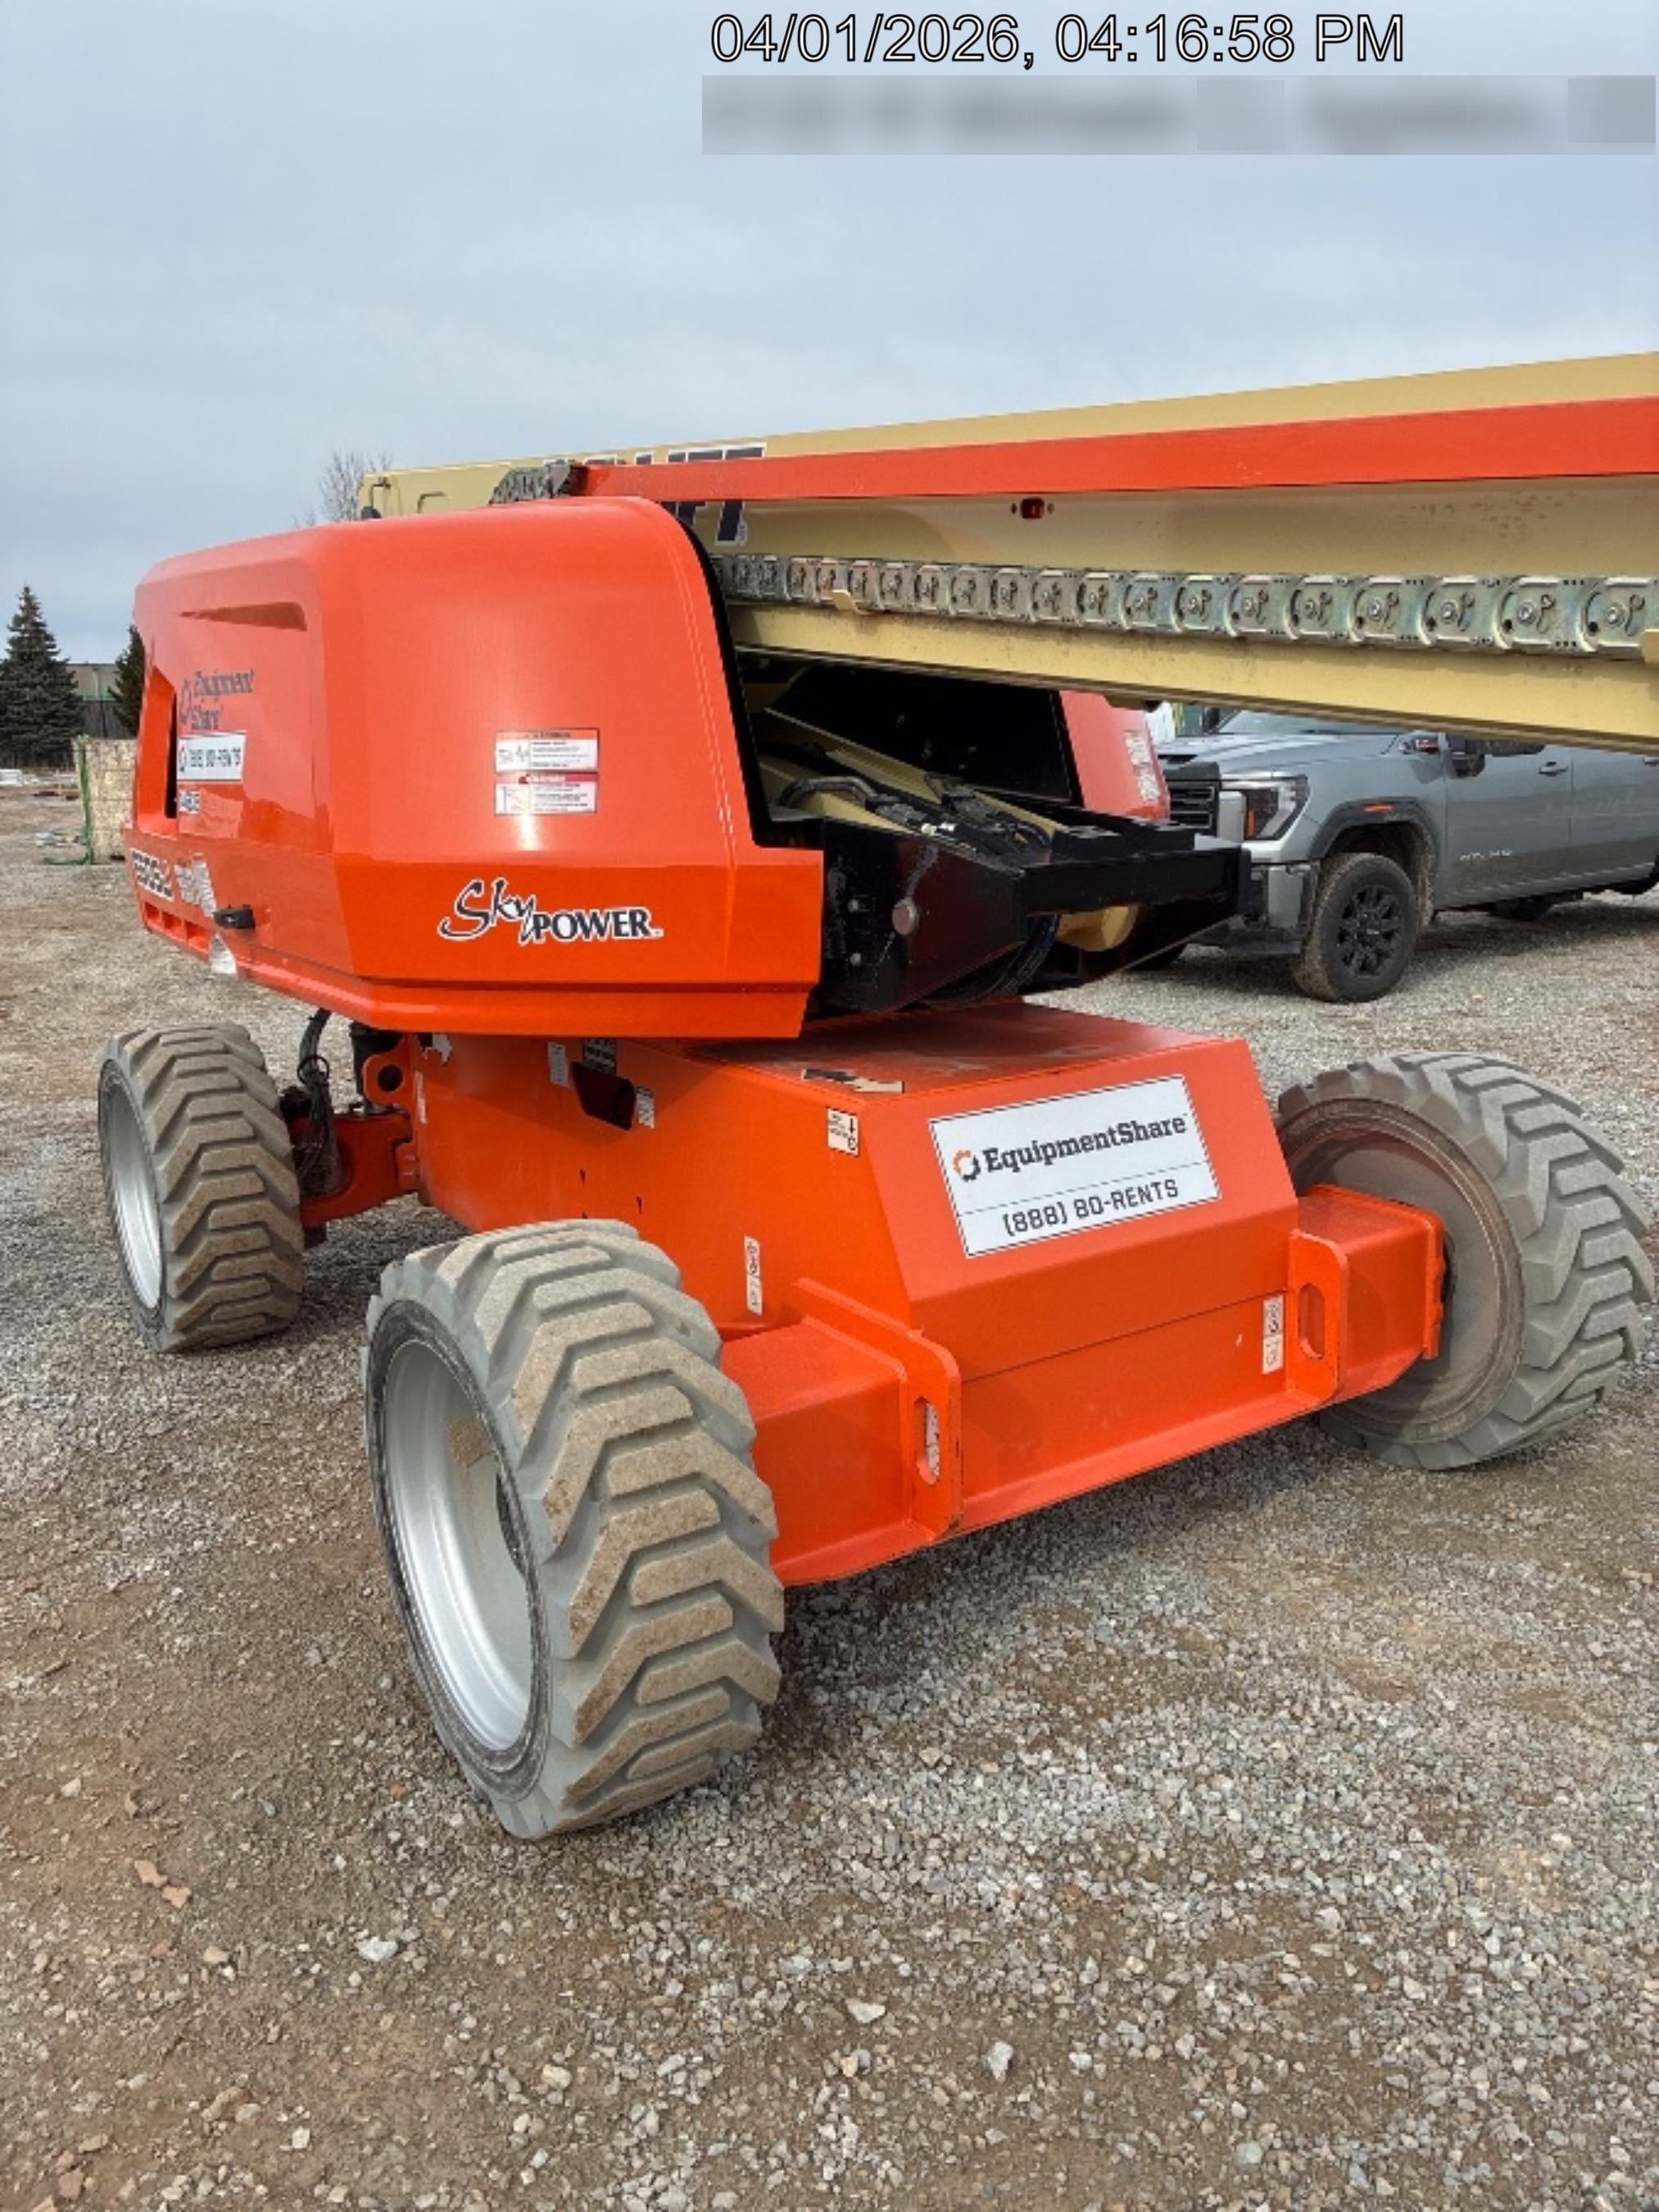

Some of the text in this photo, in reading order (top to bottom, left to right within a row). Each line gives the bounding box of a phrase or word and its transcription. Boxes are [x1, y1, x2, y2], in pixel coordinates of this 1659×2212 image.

[983, 1114, 1187, 1173] EquipmentShare
[1003, 1179, 1180, 1236] (888) 80-RENTS
